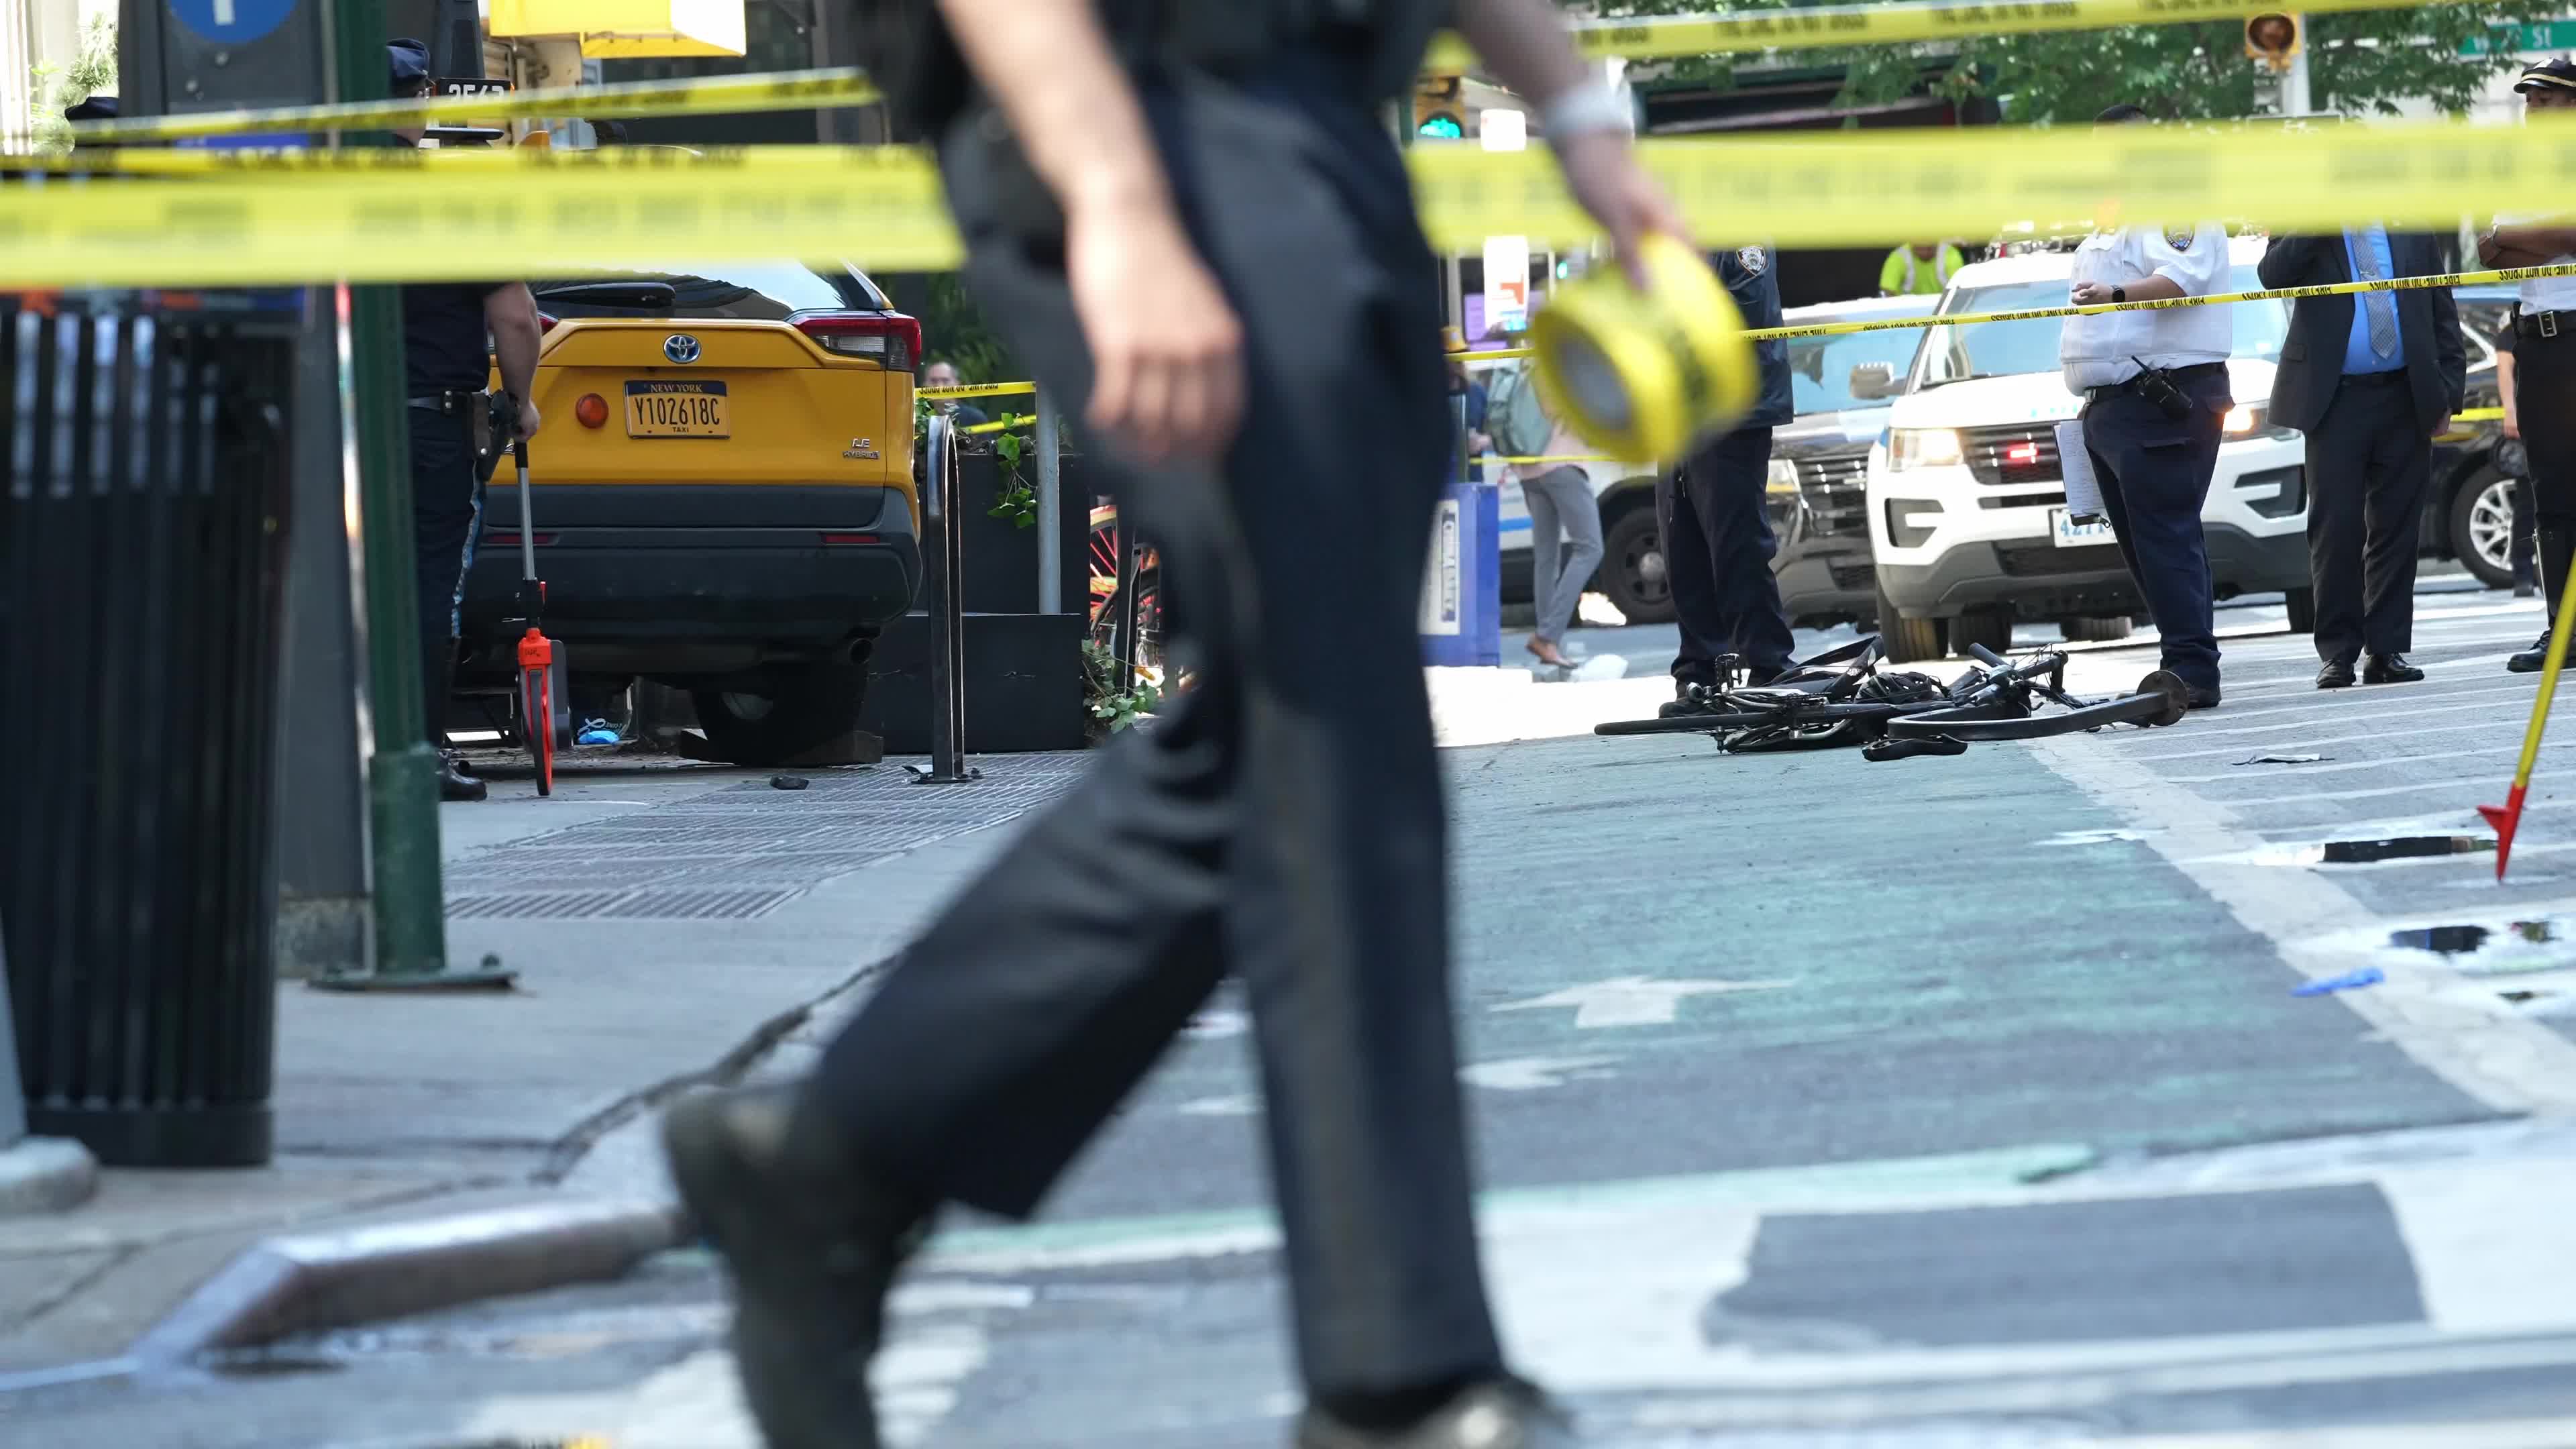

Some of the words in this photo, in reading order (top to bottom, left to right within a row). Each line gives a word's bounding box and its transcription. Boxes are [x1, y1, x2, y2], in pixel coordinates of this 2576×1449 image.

[2532, 27, 2552, 48] St
[650, 384, 675, 392] NEW
[677, 384, 703, 392] YORK
[635, 397, 720, 425] Y102618C
[852, 438, 870, 447] LE
